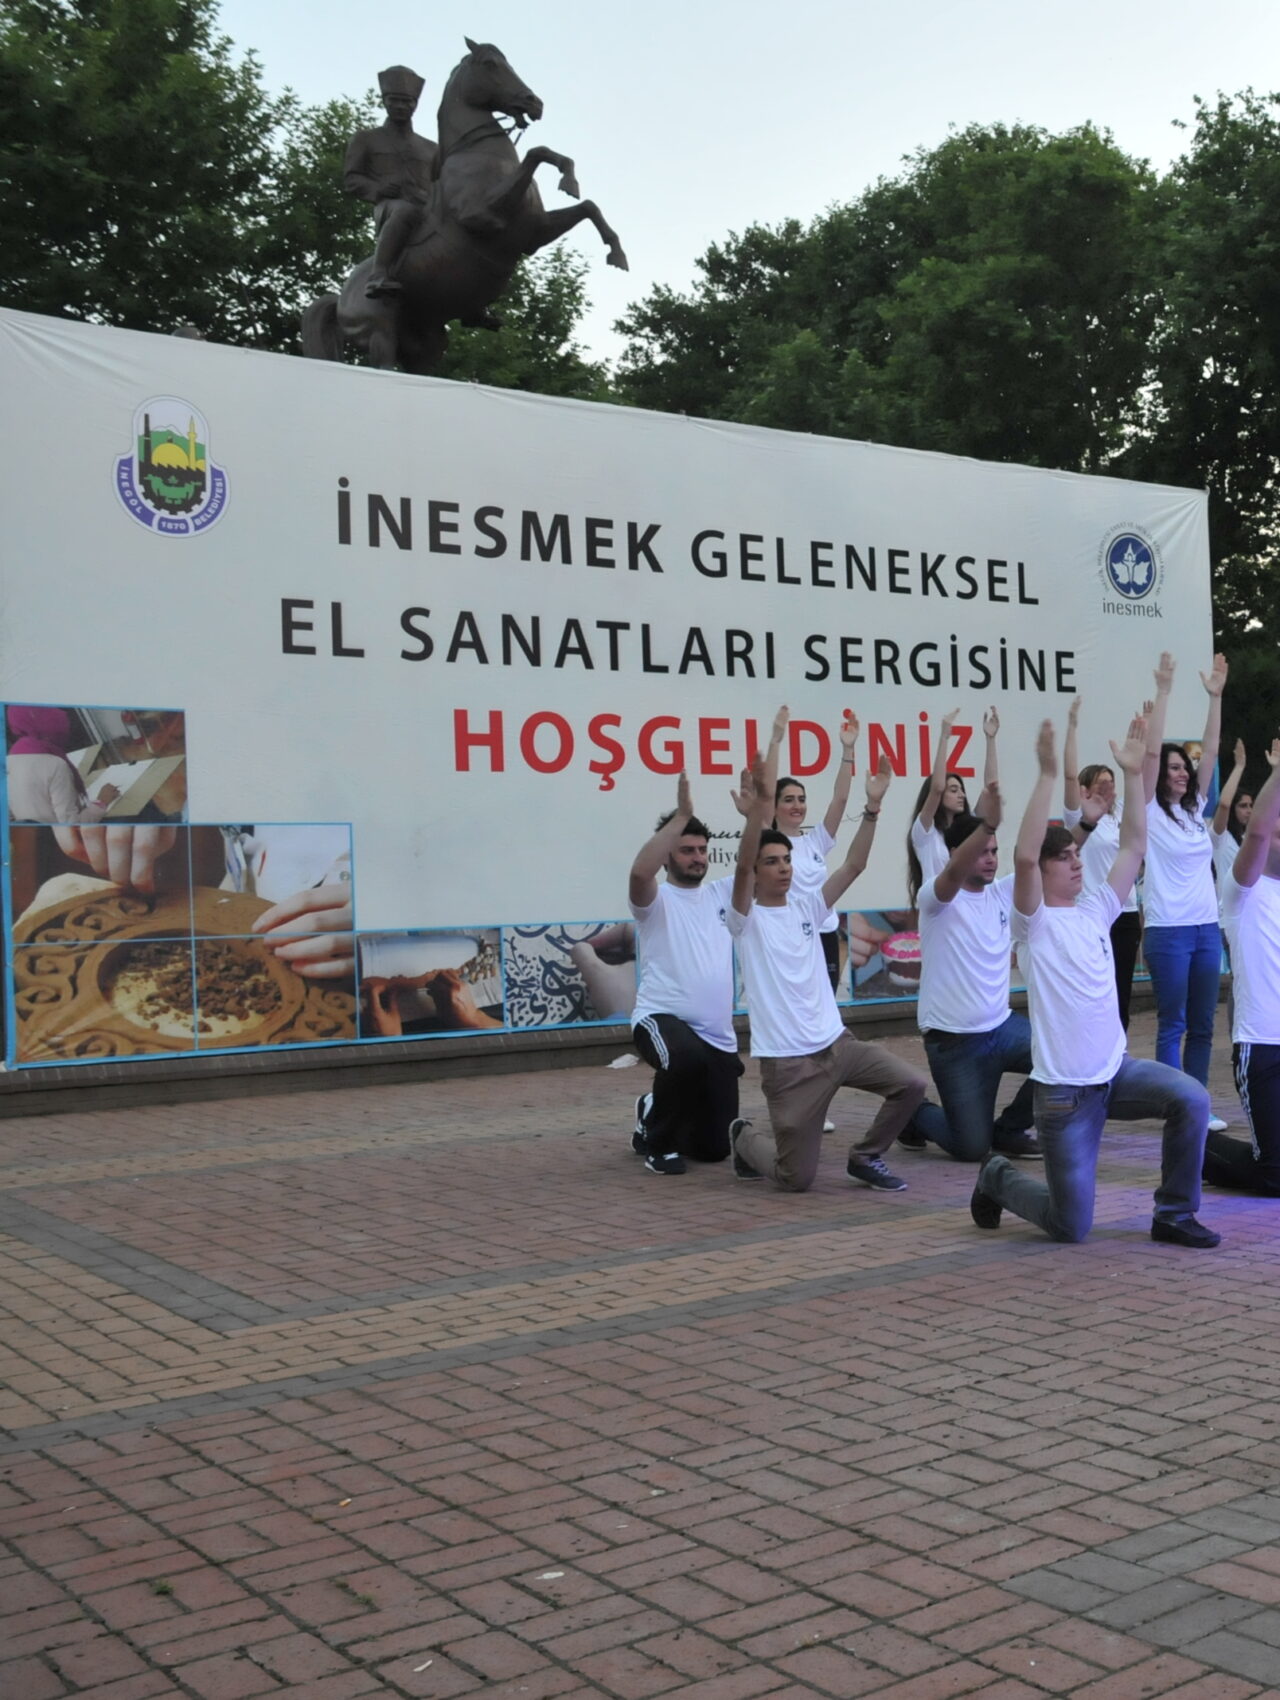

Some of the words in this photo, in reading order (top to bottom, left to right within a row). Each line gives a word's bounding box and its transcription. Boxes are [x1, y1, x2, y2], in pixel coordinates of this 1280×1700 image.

[338, 476, 665, 574] İNESMEK
[690, 528, 1040, 606] GELENEKSEL
[281, 597, 366, 659] EL
[399, 606, 776, 680] SANATLARI
[803, 633, 1078, 693] SERGİSİNE
[1102, 597, 1163, 618] inesmek
[454, 707, 977, 791] HOŞGELDNİZ
